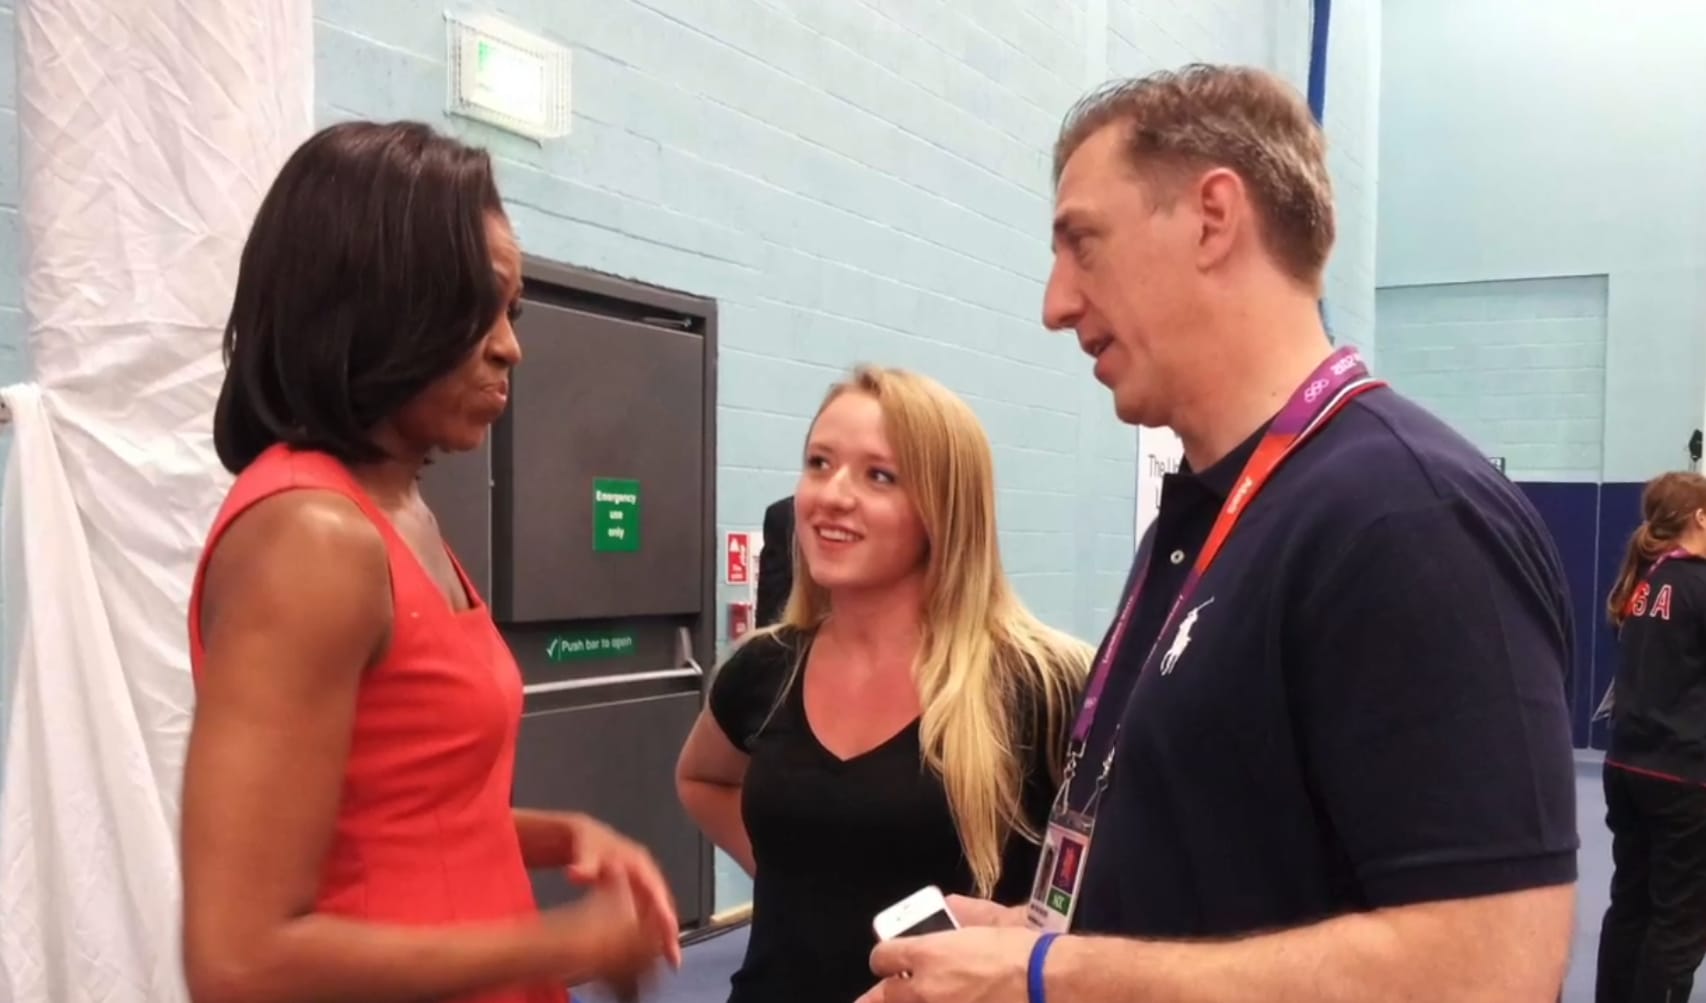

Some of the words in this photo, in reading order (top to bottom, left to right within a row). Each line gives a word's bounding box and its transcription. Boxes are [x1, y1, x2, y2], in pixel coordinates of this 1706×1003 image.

[1147, 453, 1166, 478] The
[596, 490, 637, 505] Emergency
[609, 510, 624, 520] use
[608, 526, 625, 540] only
[1625, 582, 1672, 620] SA
[561, 639, 584, 653] Push
[585, 639, 600, 651] bar
[601, 638, 611, 649] to
[611, 636, 632, 650] open
